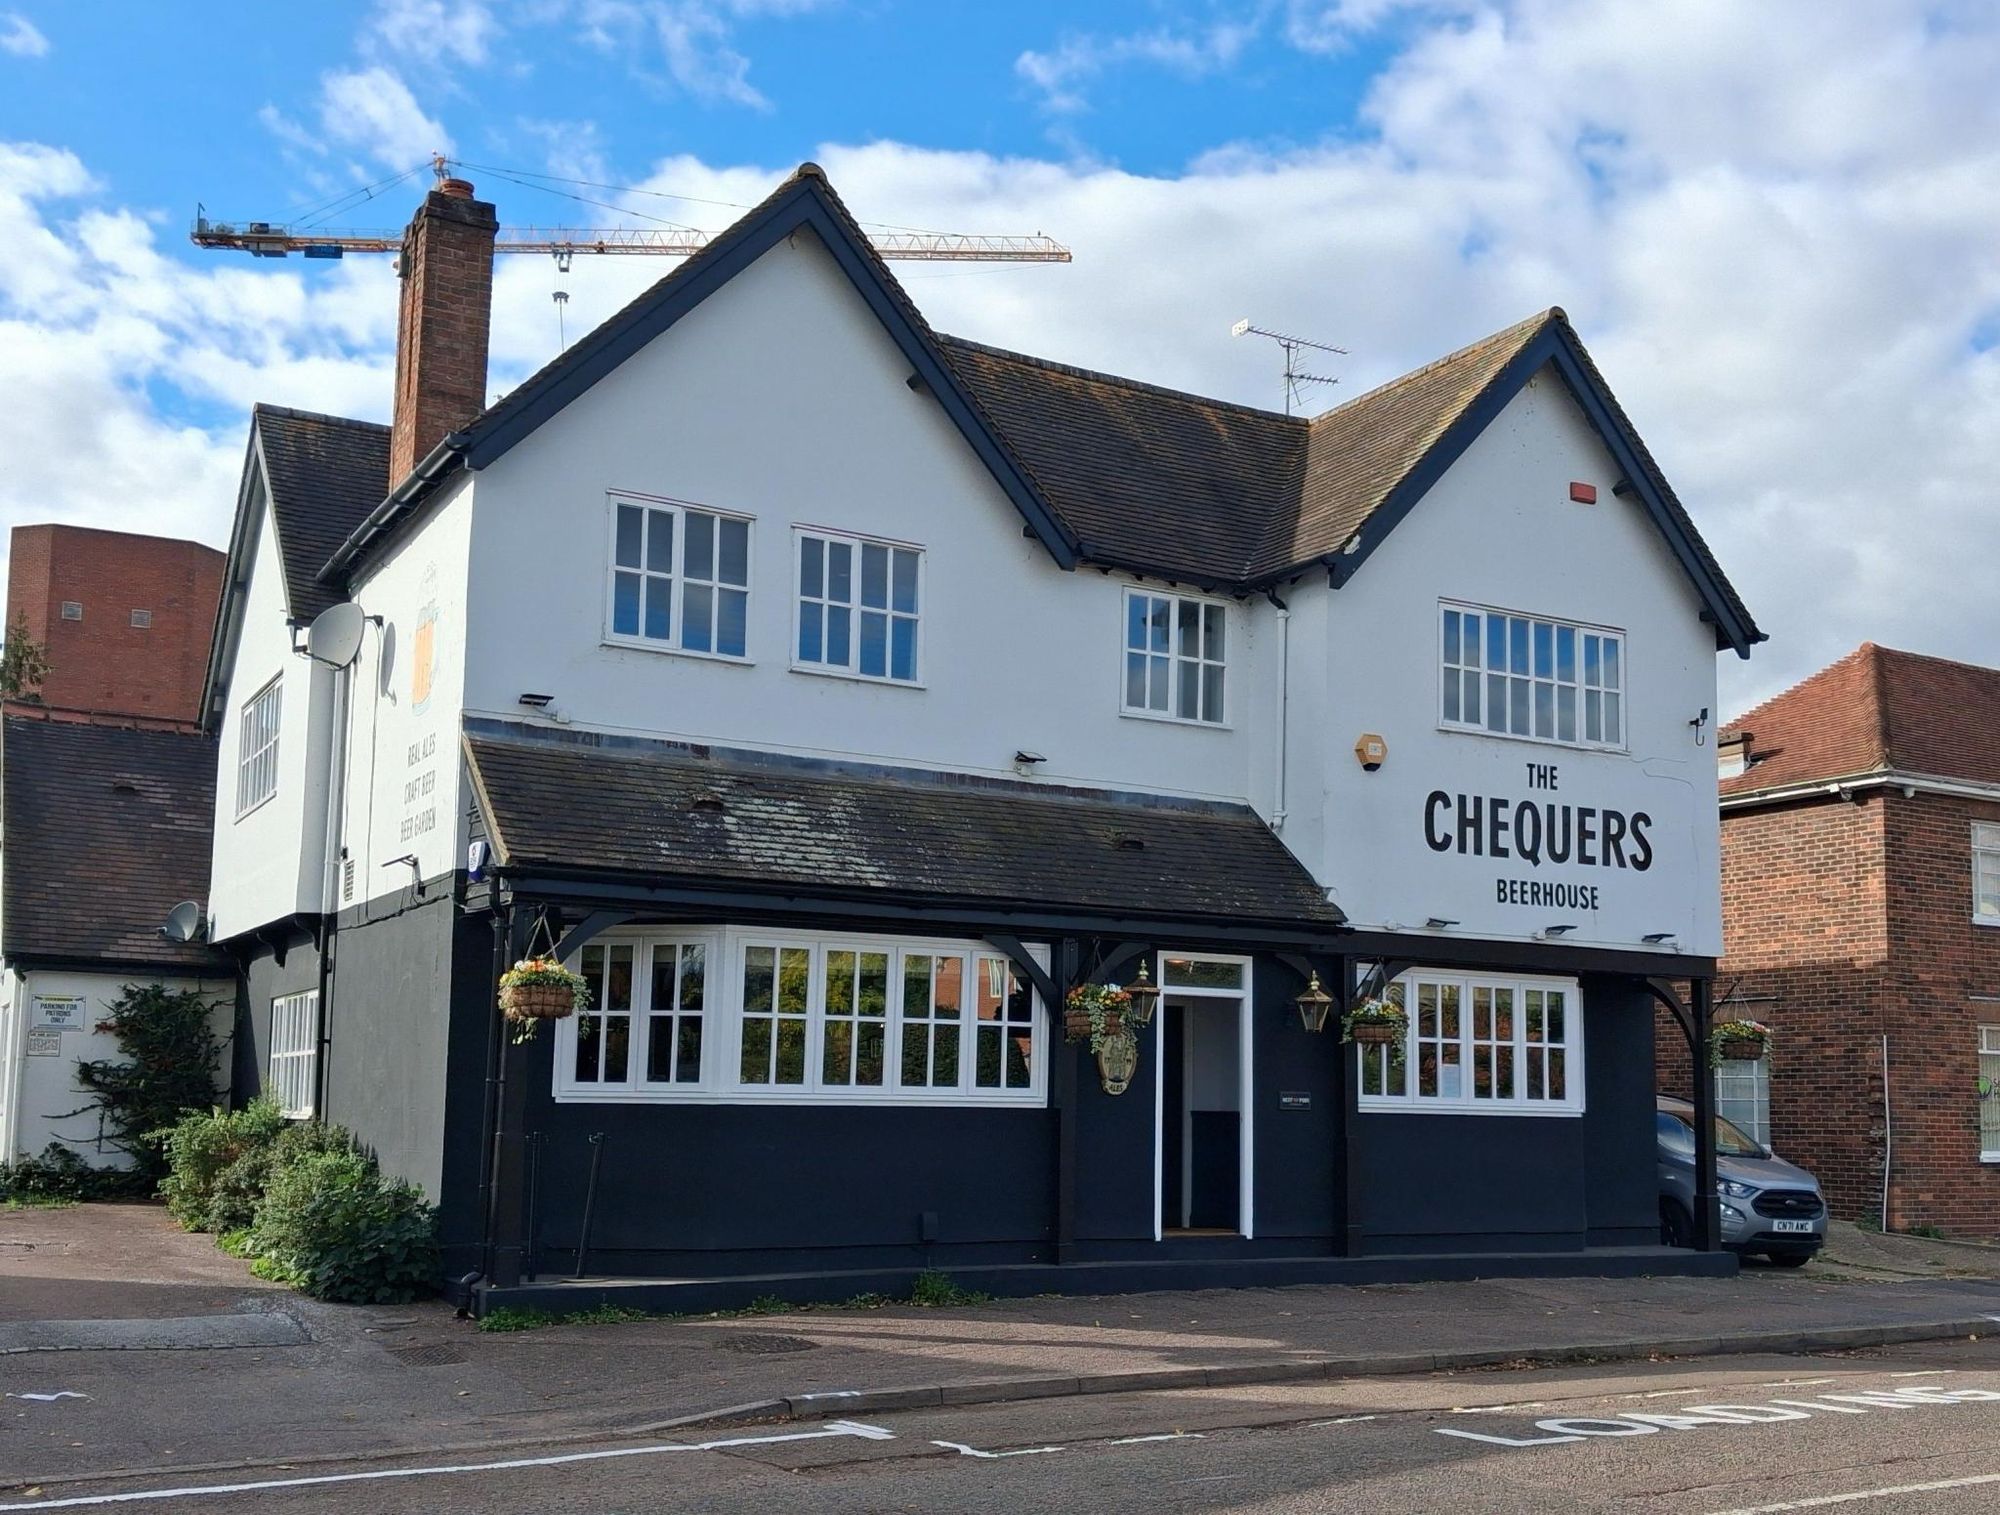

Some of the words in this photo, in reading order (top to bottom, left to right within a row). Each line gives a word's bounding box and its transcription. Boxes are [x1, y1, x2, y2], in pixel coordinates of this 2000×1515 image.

[407, 741, 421, 768] REAL
[421, 732, 436, 760] ALES
[404, 776, 421, 804] CRAFT
[421, 769, 436, 797] BEER
[1526, 763, 1558, 790] THE
[400, 816, 414, 843] BEER
[414, 806, 436, 837] GARDEN
[1424, 790, 1653, 872] CHEQUERS
[1496, 879, 1599, 910] BEERHOUSE
[40, 1003, 65, 1011] PARKING
[66, 1003, 78, 1011] FOR
[1433, 1386, 2000, 1447] LOADING
